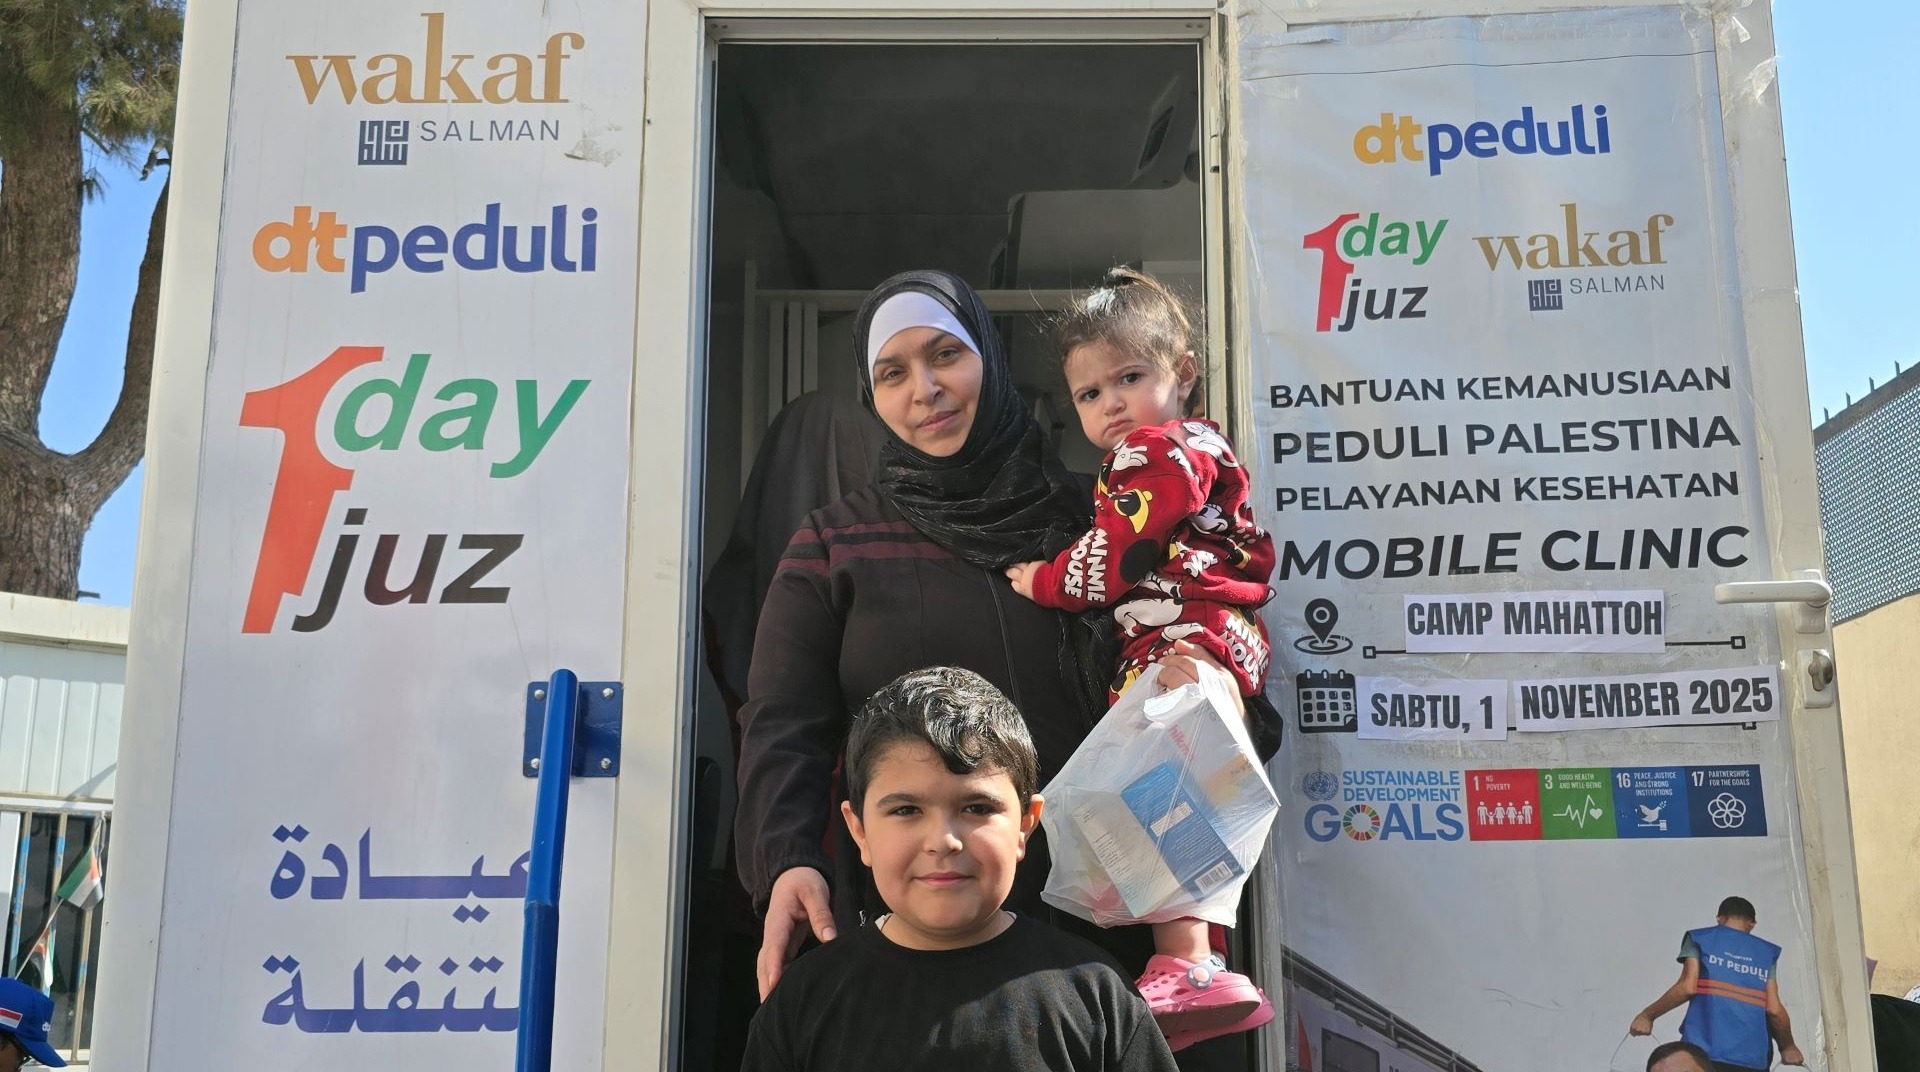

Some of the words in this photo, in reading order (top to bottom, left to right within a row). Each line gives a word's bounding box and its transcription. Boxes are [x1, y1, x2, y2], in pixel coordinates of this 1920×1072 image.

[285, 12, 585, 105] wakaf
[419, 119, 560, 142] SALMAN
[1342, 212, 1449, 265] day
[1472, 203, 1674, 271] wakaf
[1570, 274, 1665, 294] SALMAN
[1338, 279, 1428, 332] juz
[1270, 378, 1445, 409] BANTUAN
[1457, 365, 1732, 400] KEMANUSIAAN
[333, 353, 592, 479] day
[1273, 425, 1449, 464] PEDULI
[1465, 416, 1741, 455] PALESTINA
[1275, 478, 1501, 512] PELAYANAN
[1514, 471, 1739, 502] KESEHATAN
[290, 508, 525, 633] juz
[1087, 528, 1108, 602] MINNIE
[1278, 532, 1522, 581] MOBILE
[1541, 525, 1750, 572] CLINIC
[1407, 601, 1493, 636] CAMP
[1504, 600, 1662, 636] MAHATTOH
[1370, 693, 1470, 734] SABTU,
[1479, 696, 1493, 730] 1
[1521, 682, 1680, 721] NOVEMBER
[1689, 676, 1773, 716] 2025
[1343, 770, 1460, 786] SUSTAINABLE
[1343, 788, 1460, 802] DEVELOPMENT
[1473, 775, 1480, 791] 1
[1486, 783, 1511, 791] POVERTY
[1544, 774, 1553, 790] 3
[1558, 773, 1574, 781] GOOD
[1574, 773, 1595, 781] HEALTH
[1571, 781, 1602, 789] WELL-BEING
[1616, 772, 1631, 788] 16
[1654, 771, 1677, 779] JUSTICE
[1648, 780, 1669, 788] STRONG
[1691, 771, 1704, 787] 17
[1708, 770, 1750, 778] PARTNERSHIPS
[1732, 778, 1750, 786] GOALS
[1304, 803, 1464, 842] GOALS
[1709, 954, 1724, 967] DT
[1727, 960, 1768, 978] PEDULI
[261, 954, 521, 1033] تنقلة
